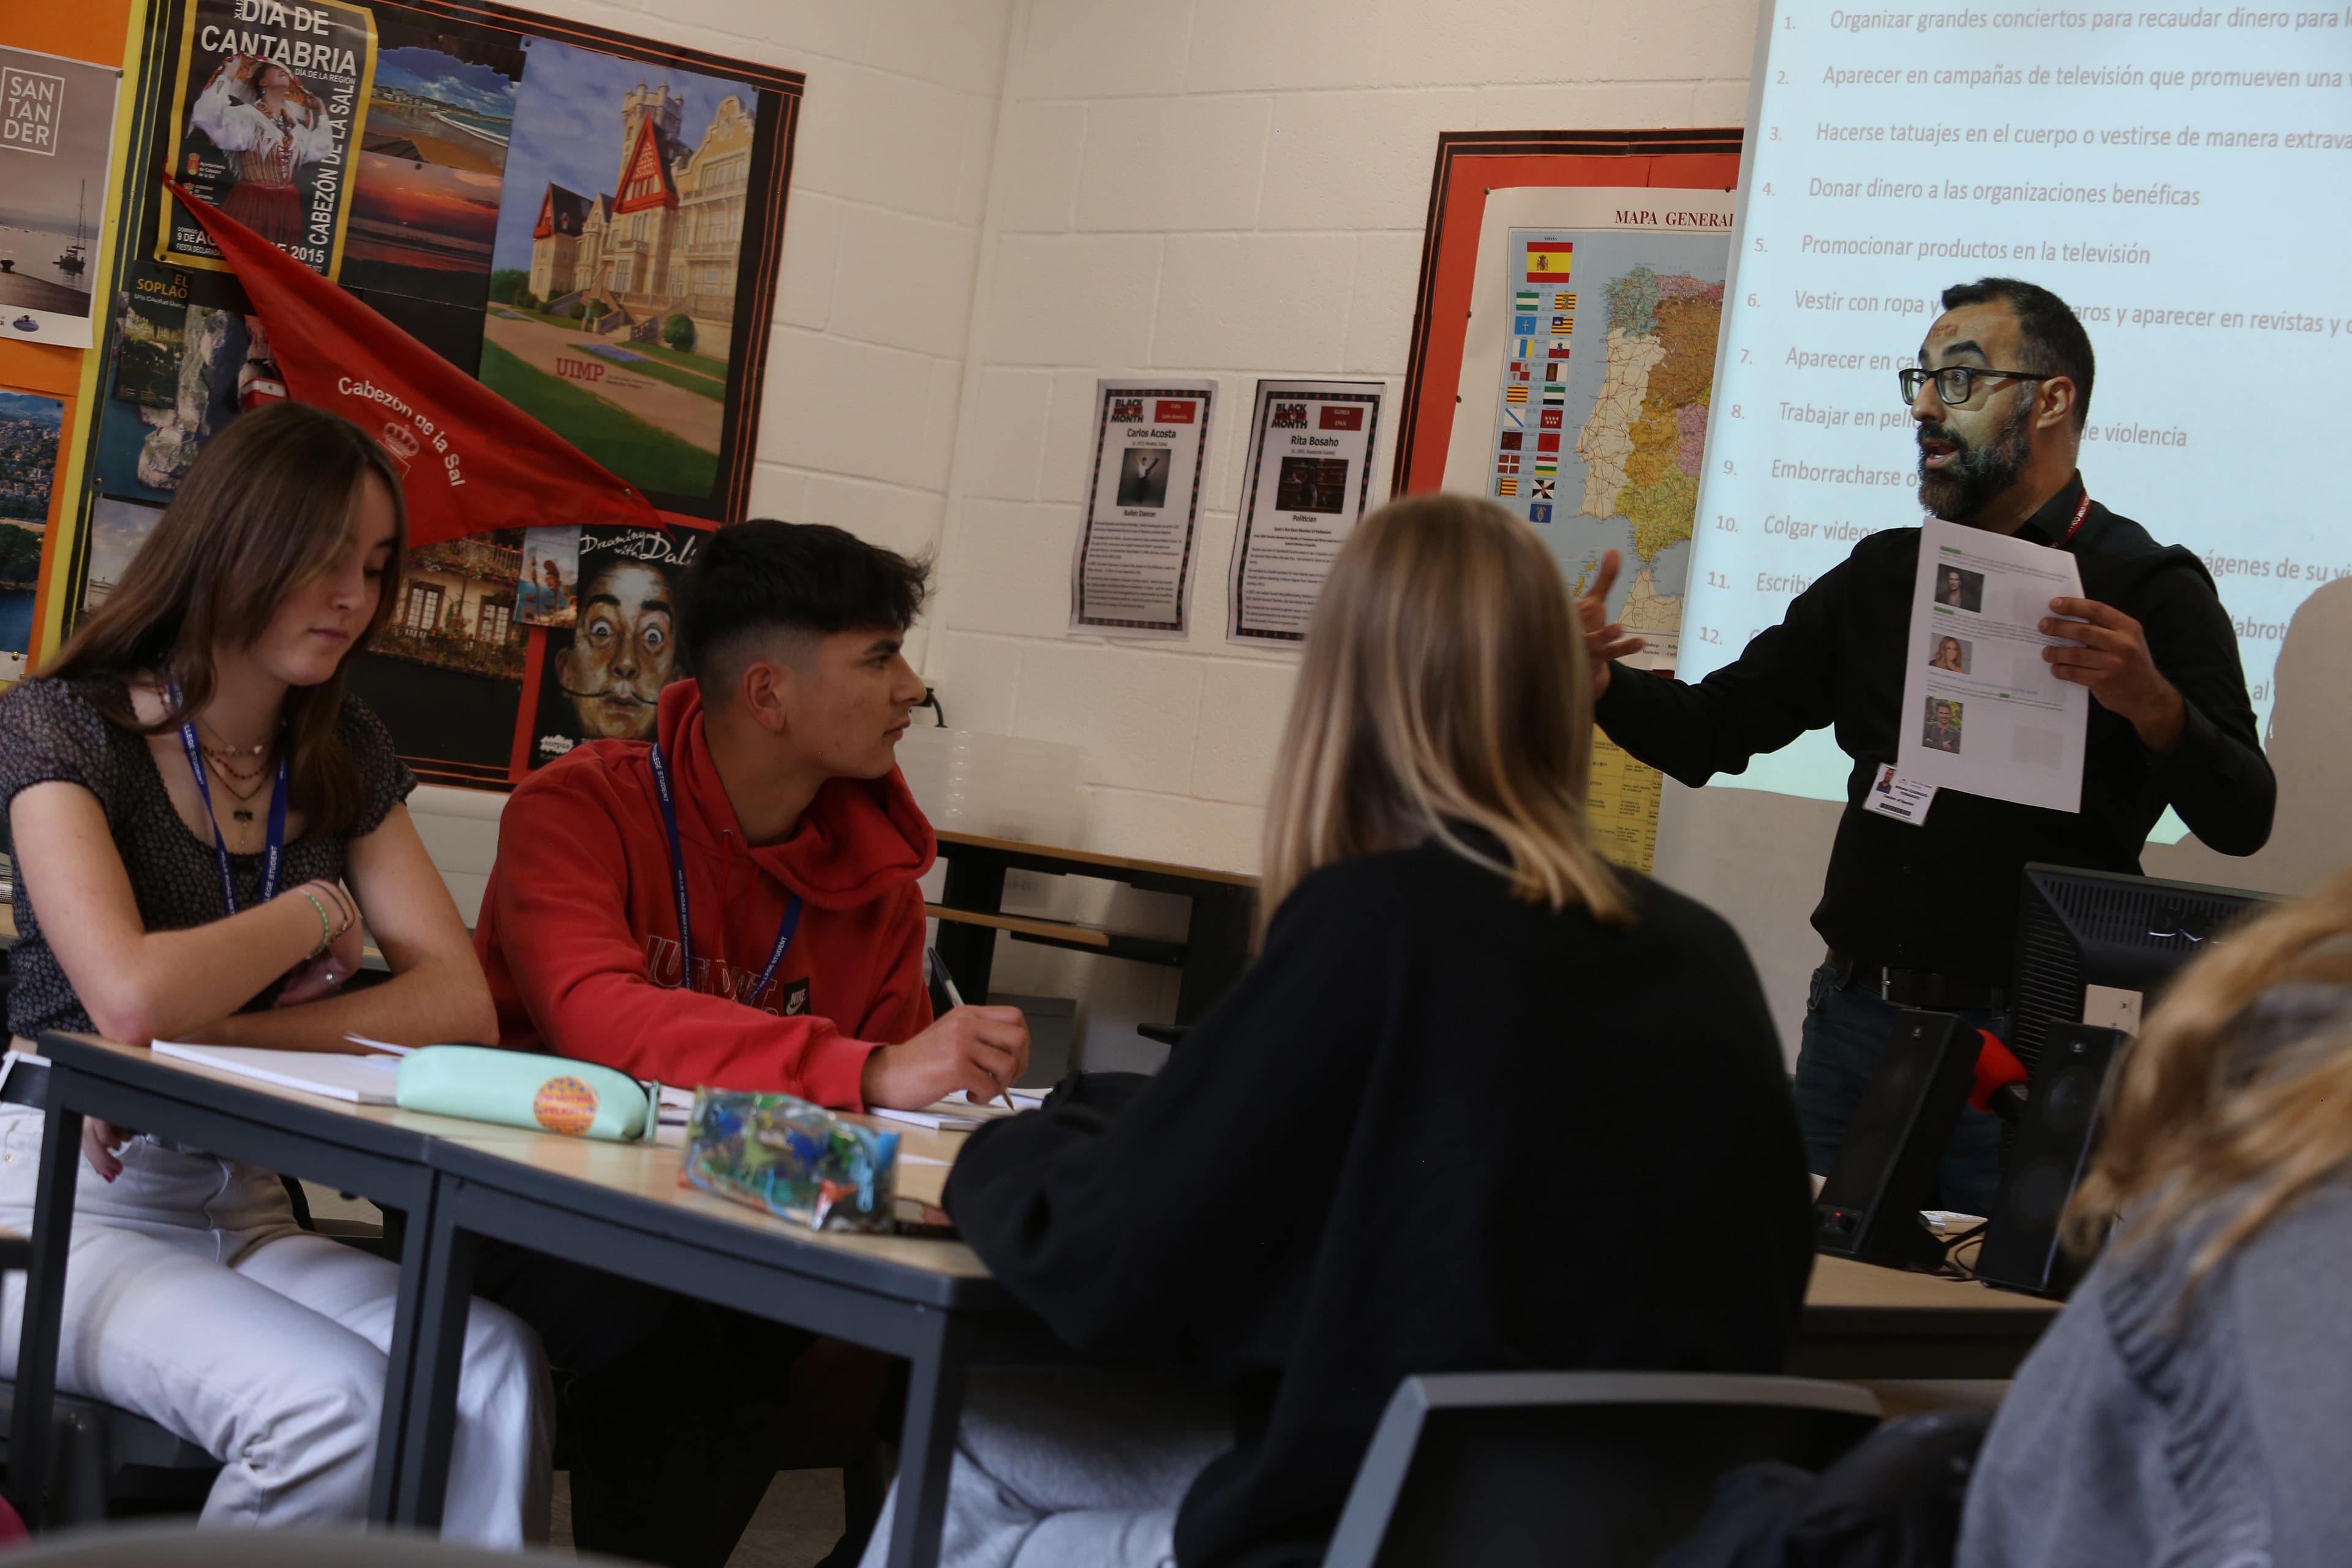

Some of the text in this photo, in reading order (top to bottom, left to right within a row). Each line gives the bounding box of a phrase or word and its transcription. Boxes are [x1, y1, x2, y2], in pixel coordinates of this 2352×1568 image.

[294, 6, 329, 36] DE
[1784, 16, 1796, 30] 1.
[1831, 10, 1913, 32] Organizar
[1917, 8, 1987, 32] grandes
[1993, 9, 2086, 29] conciertos
[2092, 11, 2132, 31] para
[2138, 7, 2222, 28] recaudar
[2227, 7, 2289, 28] dinero
[2295, 12, 2338, 32] para
[201, 25, 356, 76] CANTABRIA
[10, 76, 55, 103] SAN
[330, 74, 356, 85] REGIÓN
[1777, 72, 1789, 85] 2.
[1823, 66, 1901, 89] Aparecer
[1907, 70, 1928, 85] en
[1934, 63, 2022, 89] campañas
[2028, 66, 2050, 85] de
[2056, 64, 2144, 86] televisión
[2149, 70, 2184, 90] que
[2190, 70, 2300, 91] promueven
[2307, 71, 2342, 87] una
[8, 97, 51, 124] TAN
[4, 119, 50, 146] DER
[1769, 123, 2352, 149] 3. Hacerse tatuajes en el cuerpo o vestirse de manera extrava
[308, 168, 338, 245] CABEZÓN
[329, 85, 354, 115] SAL
[1762, 178, 2200, 206] 4. Donar dinero a las organizaciones benéficas
[1615, 210, 1658, 225] MAPA
[176, 243, 192, 252] FIESTA
[177, 232, 183, 241] 9
[184, 233, 195, 243] DE
[290, 246, 325, 263] 2015
[1755, 235, 2150, 265] 5. Promocionar productos en la televisión
[137, 279, 188, 299] SOPLAO
[175, 274, 189, 288] EL
[1747, 294, 1760, 307] 6.
[1795, 290, 1844, 311] Vestir
[1849, 296, 1878, 312] con
[1884, 298, 1924, 317] ropa
[1930, 300, 1940, 318] y
[2117, 308, 2127, 327] y
[2132, 308, 2215, 328] aparecer
[2221, 314, 2244, 328] en
[2250, 311, 2323, 332] revistas
[2329, 318, 2341, 338] y
[556, 357, 605, 382] UIMP
[1741, 349, 1752, 364] 7.
[1786, 347, 1865, 370] Aparecer
[1870, 355, 1890, 370] en
[1127, 428, 1177, 439] Carlos Acosta
[1271, 420, 1308, 429] MONTH
[1732, 405, 1745, 420] 8.
[1780, 402, 1850, 429] Trabajar
[1854, 412, 1875, 426] en
[2105, 423, 2187, 447] violencia
[1291, 435, 1339, 447] Rita Bosaho
[432, 431, 448, 453] la
[445, 453, 466, 486] Sal
[1724, 461, 1737, 476] 9.
[1772, 459, 1901, 487] Emborracharse
[1716, 515, 1738, 533] 10.
[1765, 515, 1818, 540] Colgar
[2200, 549, 2269, 577] ágenes
[2277, 558, 2299, 579] de
[2305, 565, 2327, 581] su
[1708, 572, 1730, 589] 11.
[1756, 573, 1812, 594] Escribi
[1700, 627, 1723, 645] 12.
[658, 771, 669, 802] STUDENT
[269, 845, 277, 880] STUDENT
[772, 936, 787, 963] STUDENT
[790, 989, 807, 1005] NIKE
